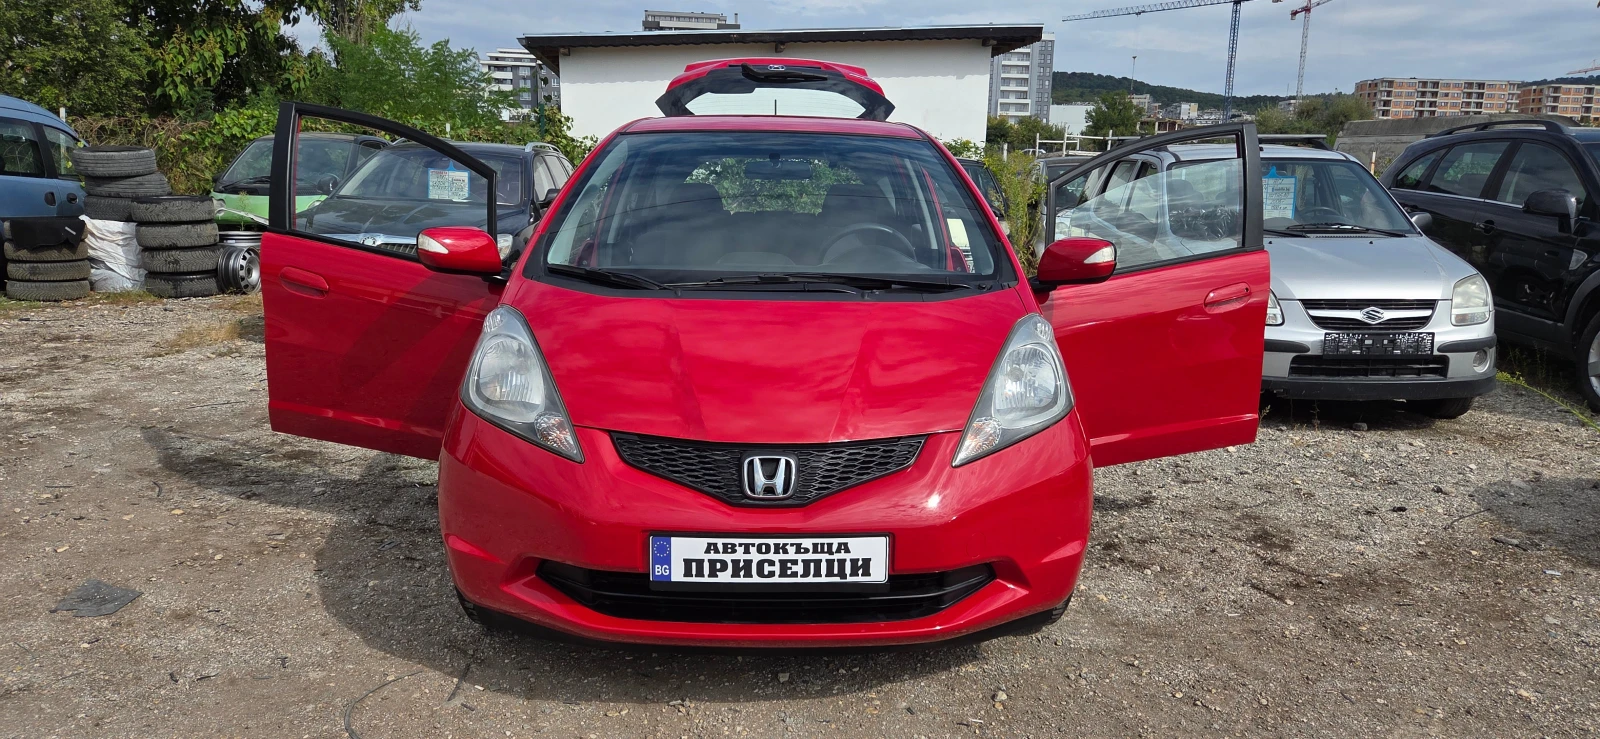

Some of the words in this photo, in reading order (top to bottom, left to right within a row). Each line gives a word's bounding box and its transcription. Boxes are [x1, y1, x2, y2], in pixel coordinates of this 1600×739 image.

[704, 542, 851, 555] АВТОКЪЩА
[655, 565, 669, 575] BG
[683, 558, 871, 580] ПРИСЕЛЦИ
